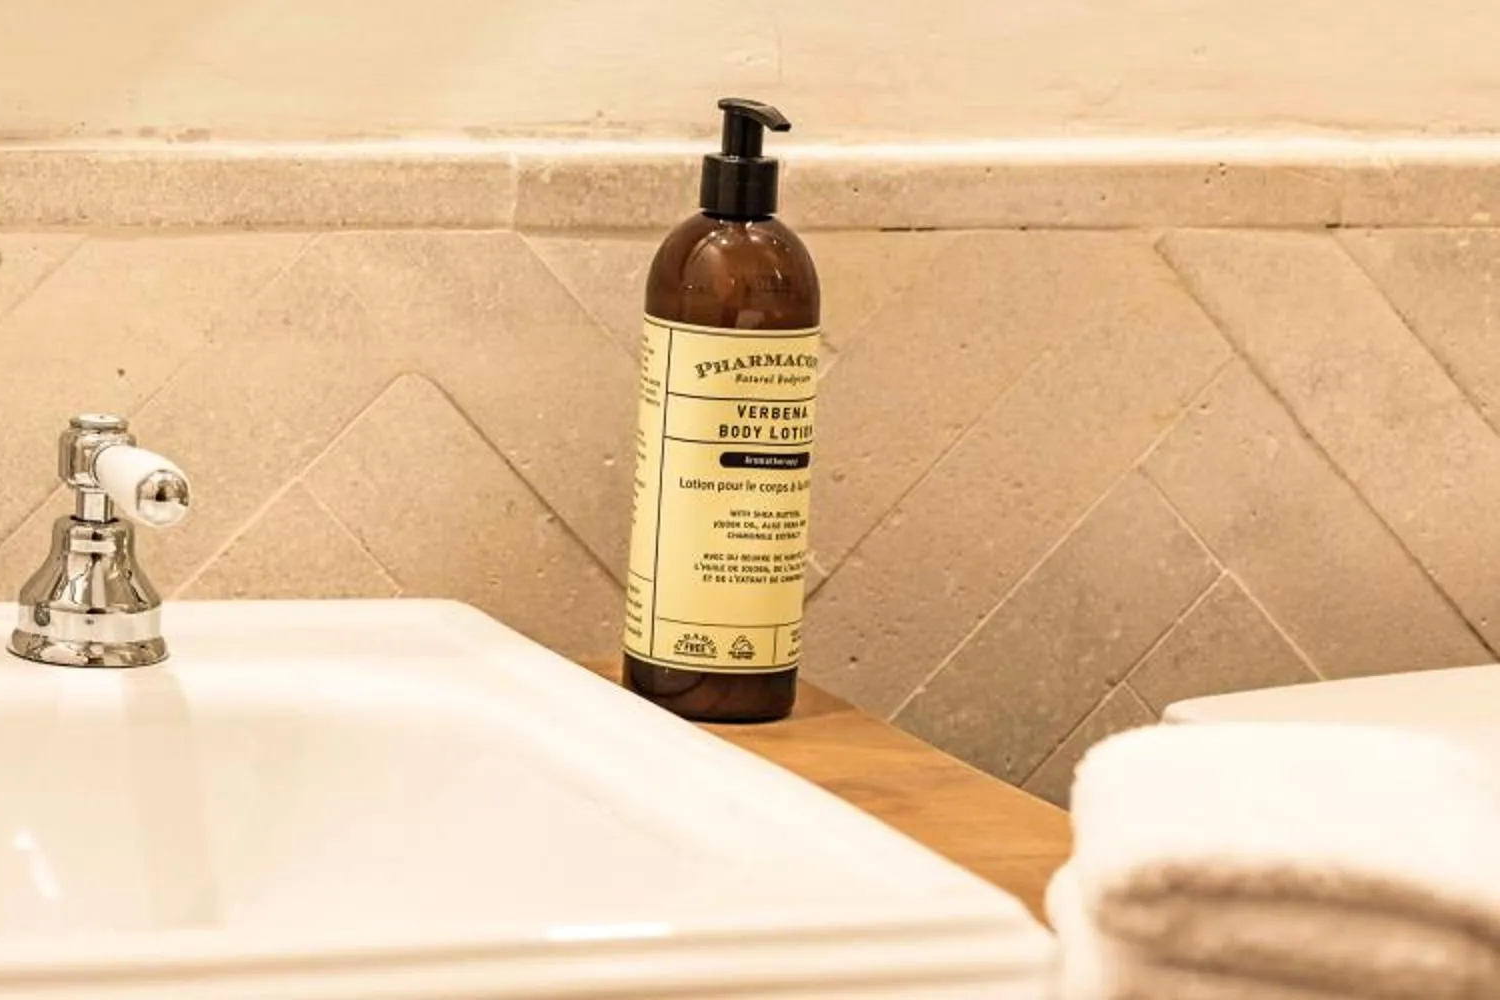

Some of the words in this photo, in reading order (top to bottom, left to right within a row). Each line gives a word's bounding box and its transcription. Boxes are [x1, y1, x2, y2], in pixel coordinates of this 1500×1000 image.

[737, 405, 808, 420] VERBENA
[719, 424, 763, 439] BODY
[678, 477, 715, 491] Lotion
[717, 480, 743, 493] pour
[759, 482, 789, 494] corps
